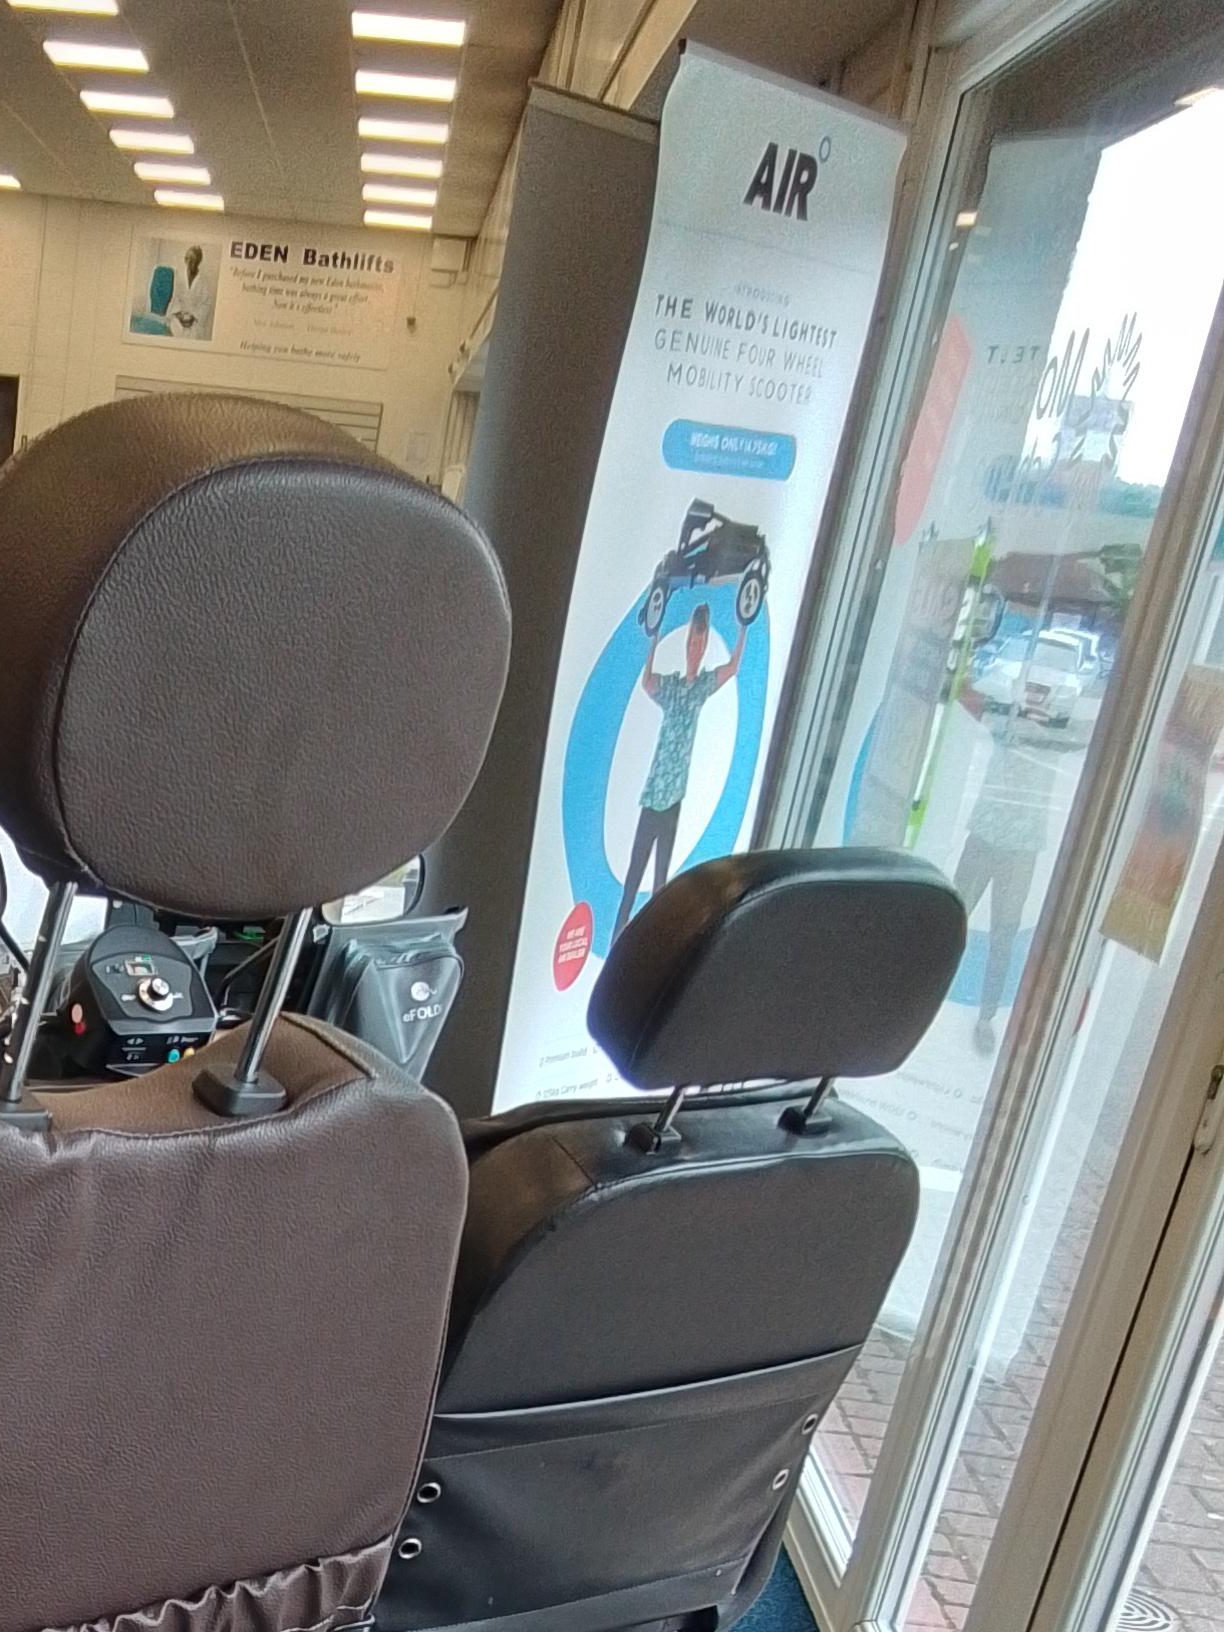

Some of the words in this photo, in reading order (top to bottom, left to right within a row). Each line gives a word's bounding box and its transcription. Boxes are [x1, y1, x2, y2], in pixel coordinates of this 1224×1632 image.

[230, 241, 289, 264] EDEN
[303, 248, 394, 273] Bathlifts
[654, 294, 693, 319] THE
[705, 301, 769, 334] WORLD'S
[772, 317, 837, 349] LIGHTEST
[654, 328, 730, 360] GENUINE
[736, 342, 775, 367] FOUR
[783, 351, 824, 379] WHEEL
[666, 363, 744, 393] MOBILITY
[749, 374, 812, 406] SCOOTER
